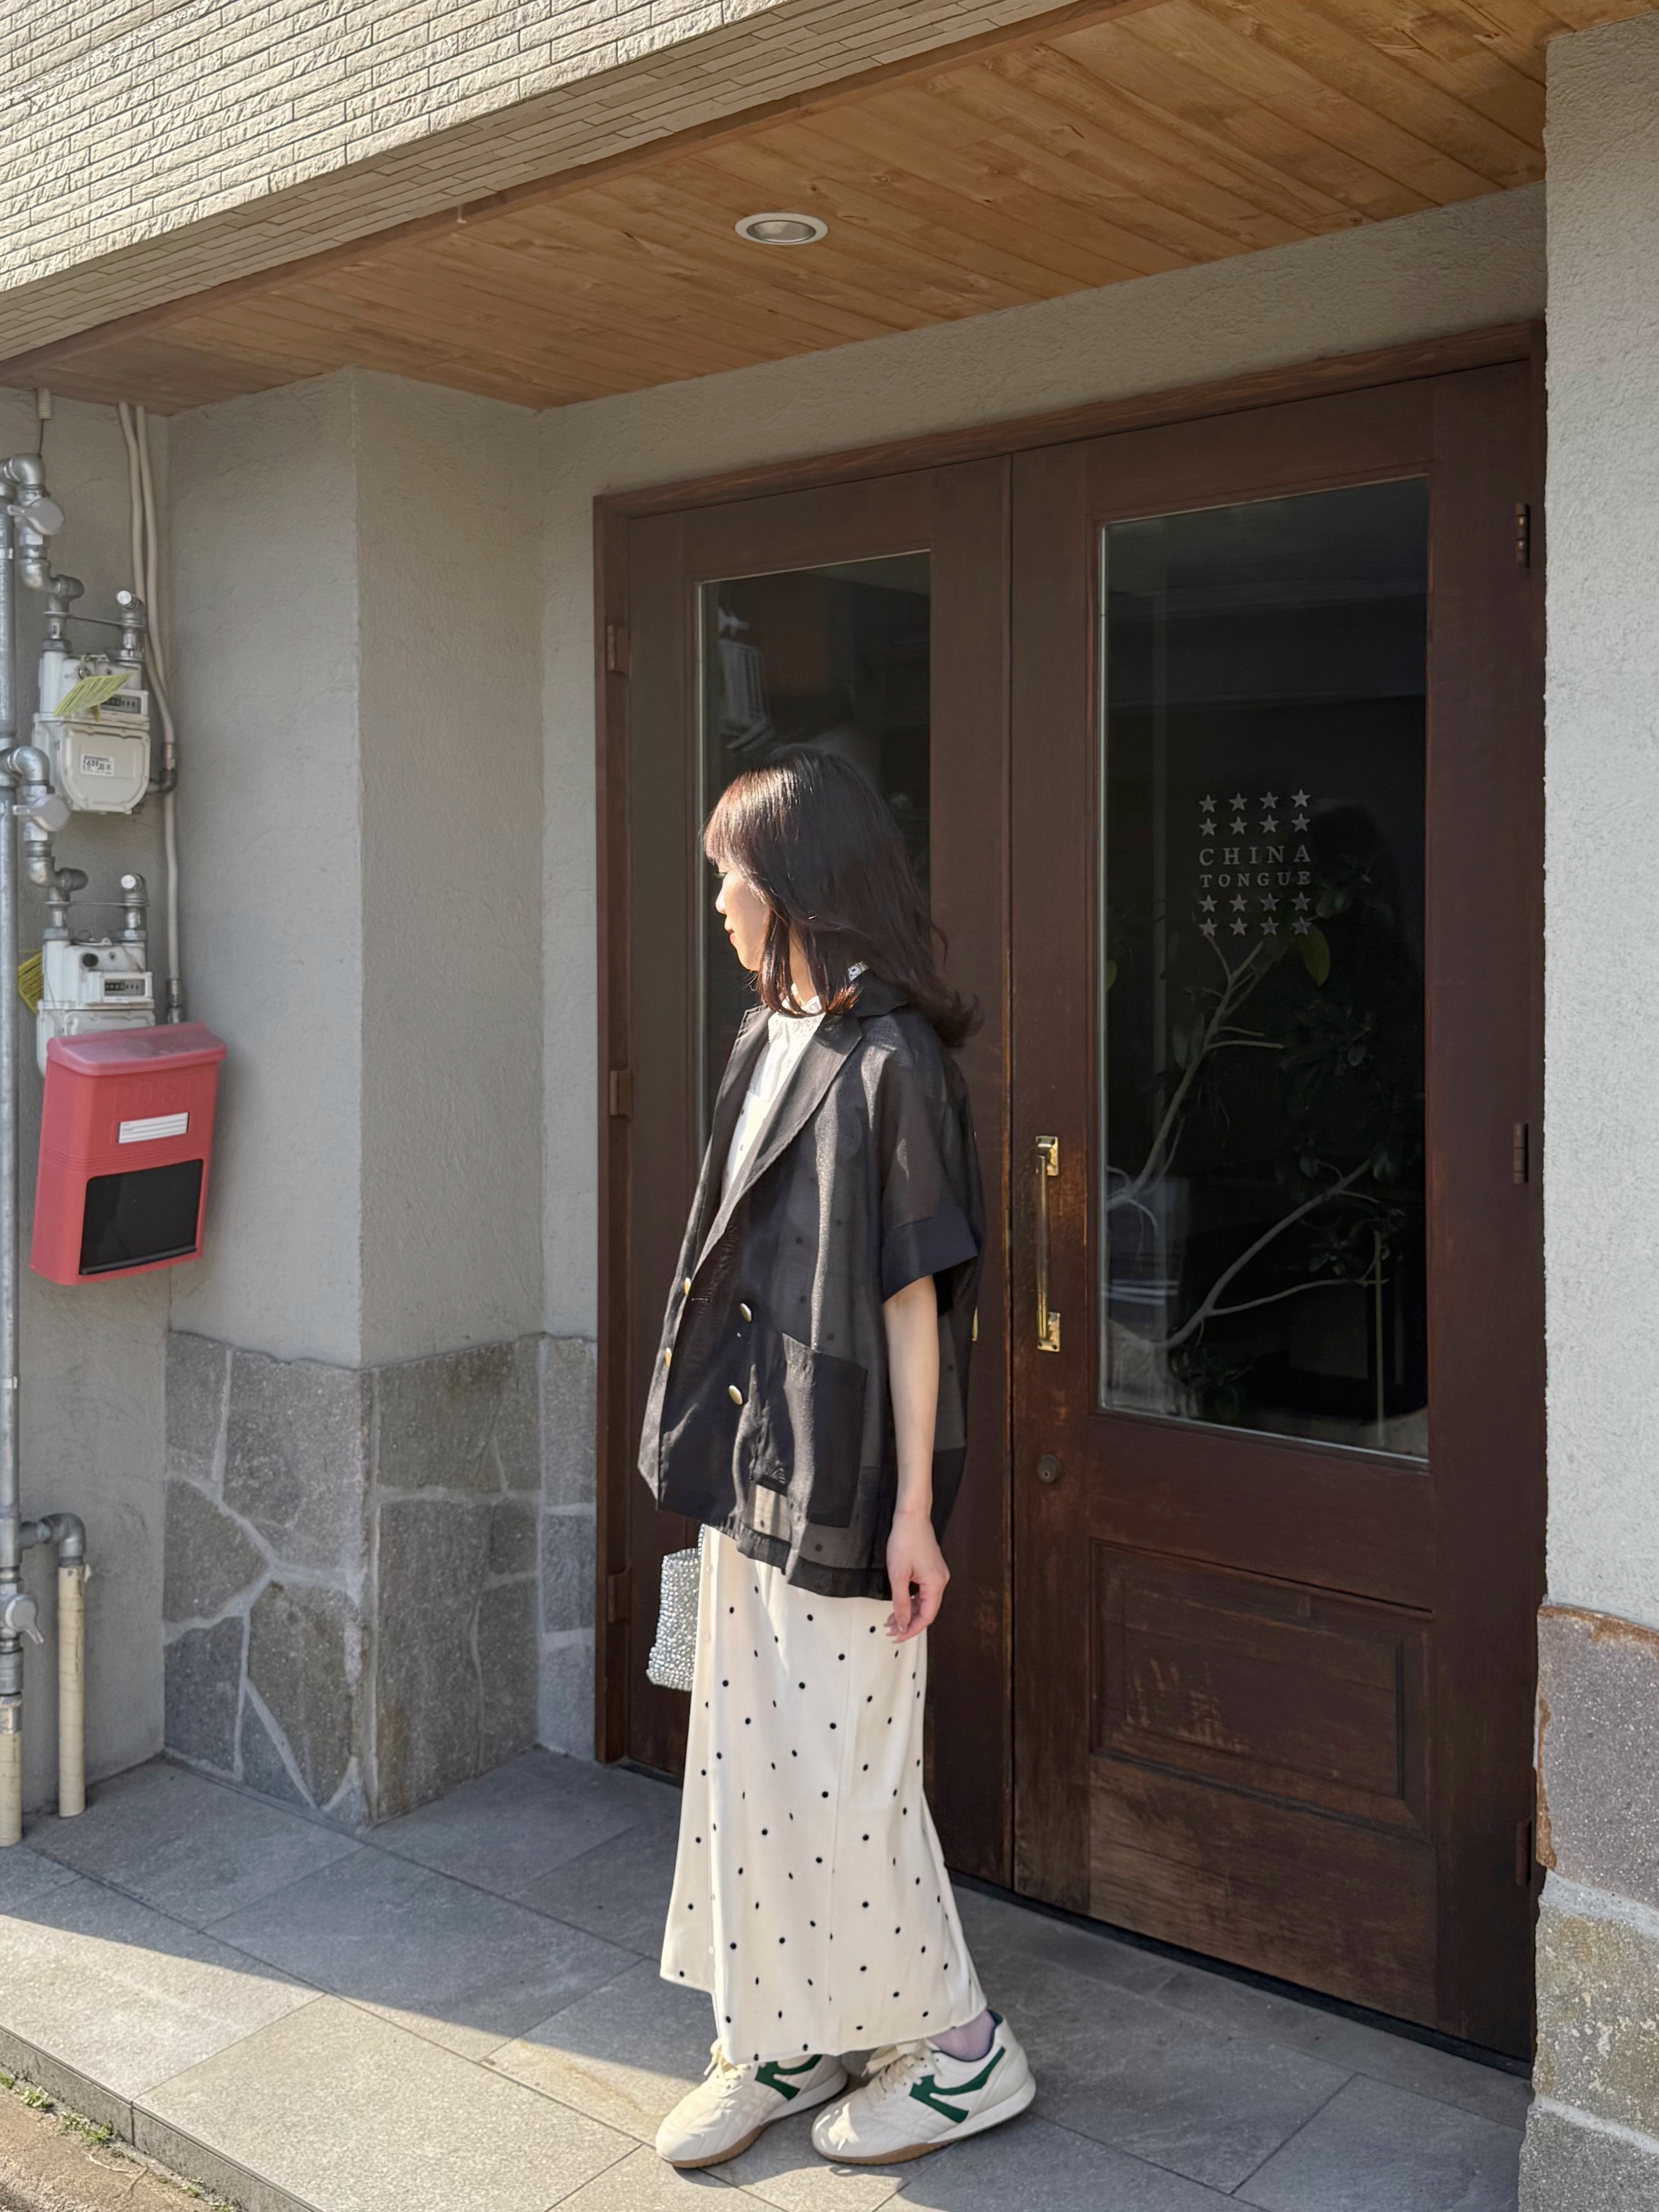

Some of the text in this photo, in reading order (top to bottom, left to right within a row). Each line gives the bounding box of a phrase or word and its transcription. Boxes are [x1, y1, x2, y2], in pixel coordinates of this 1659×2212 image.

[1198, 845, 1311, 866] CHINA
[1199, 871, 1311, 888] TONGUE
[114, 1077, 198, 1112] POST
